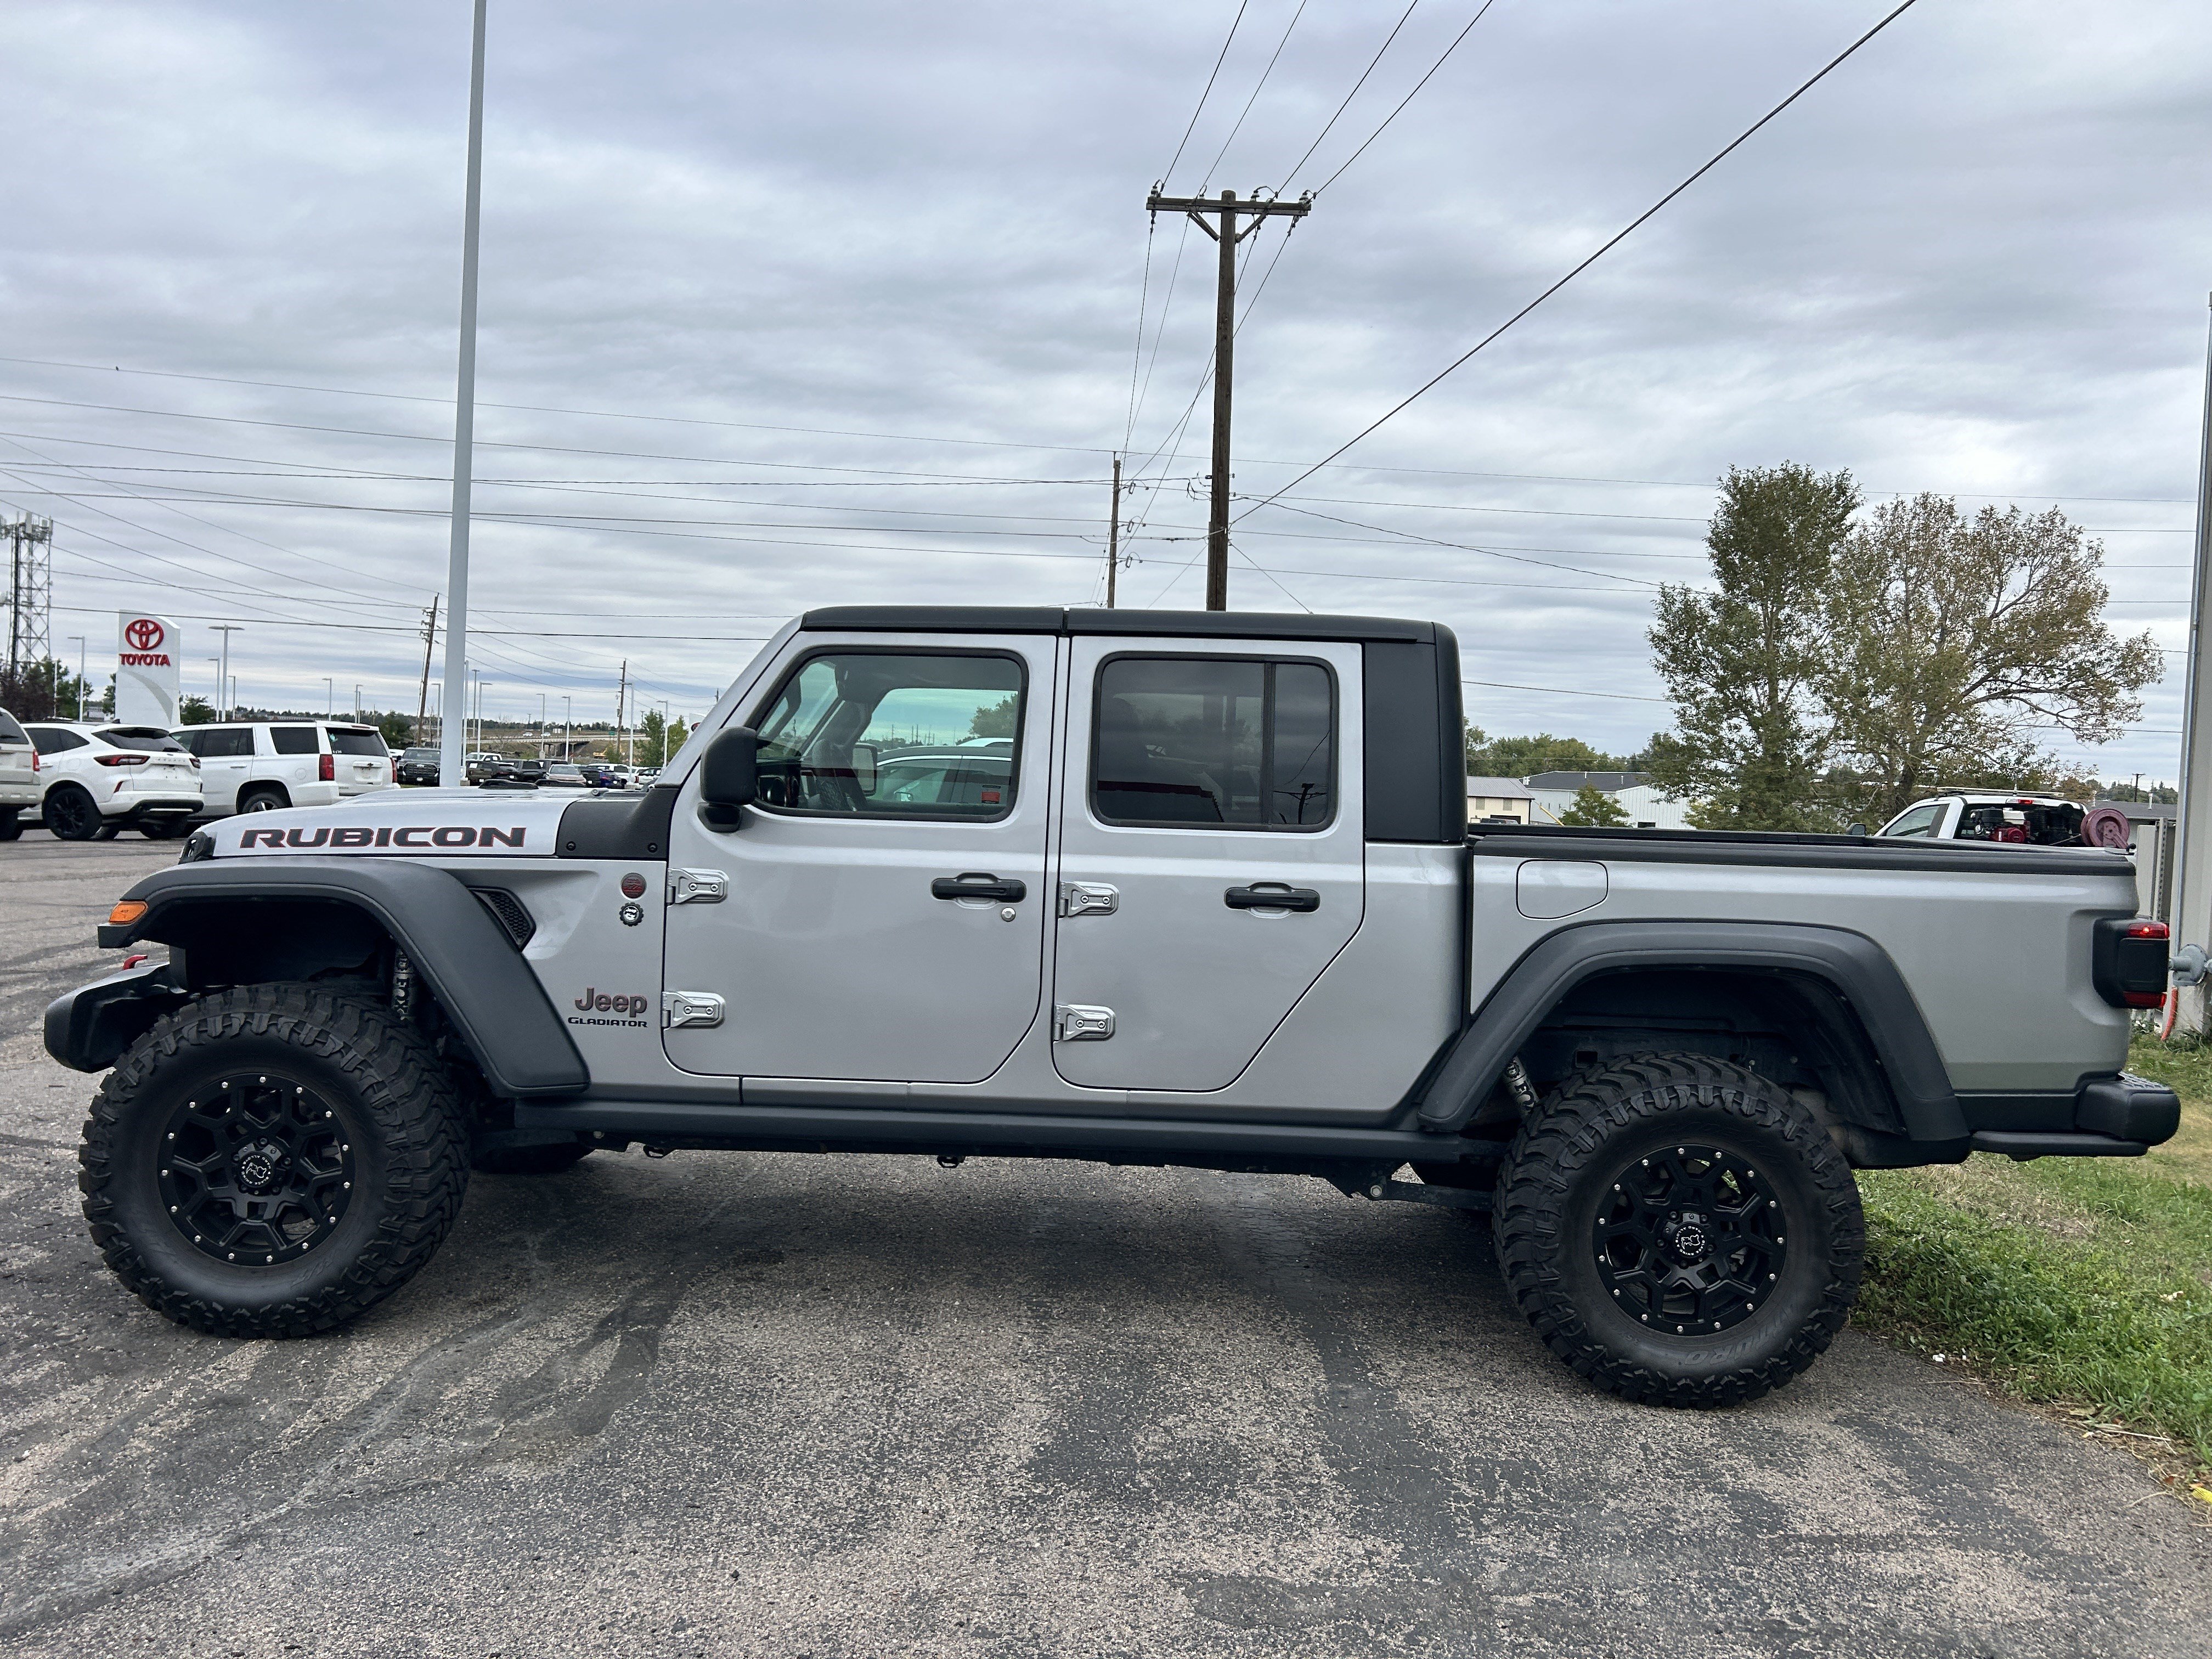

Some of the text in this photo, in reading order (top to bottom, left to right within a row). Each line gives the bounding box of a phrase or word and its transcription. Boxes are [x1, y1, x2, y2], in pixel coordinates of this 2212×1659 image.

[119, 653, 171, 667] TOYOTA
[239, 827, 526, 848] RUBICON
[396, 978, 410, 1015] FOX
[575, 987, 647, 1018] Jeep
[568, 1017, 648, 1028] GLADIATOR
